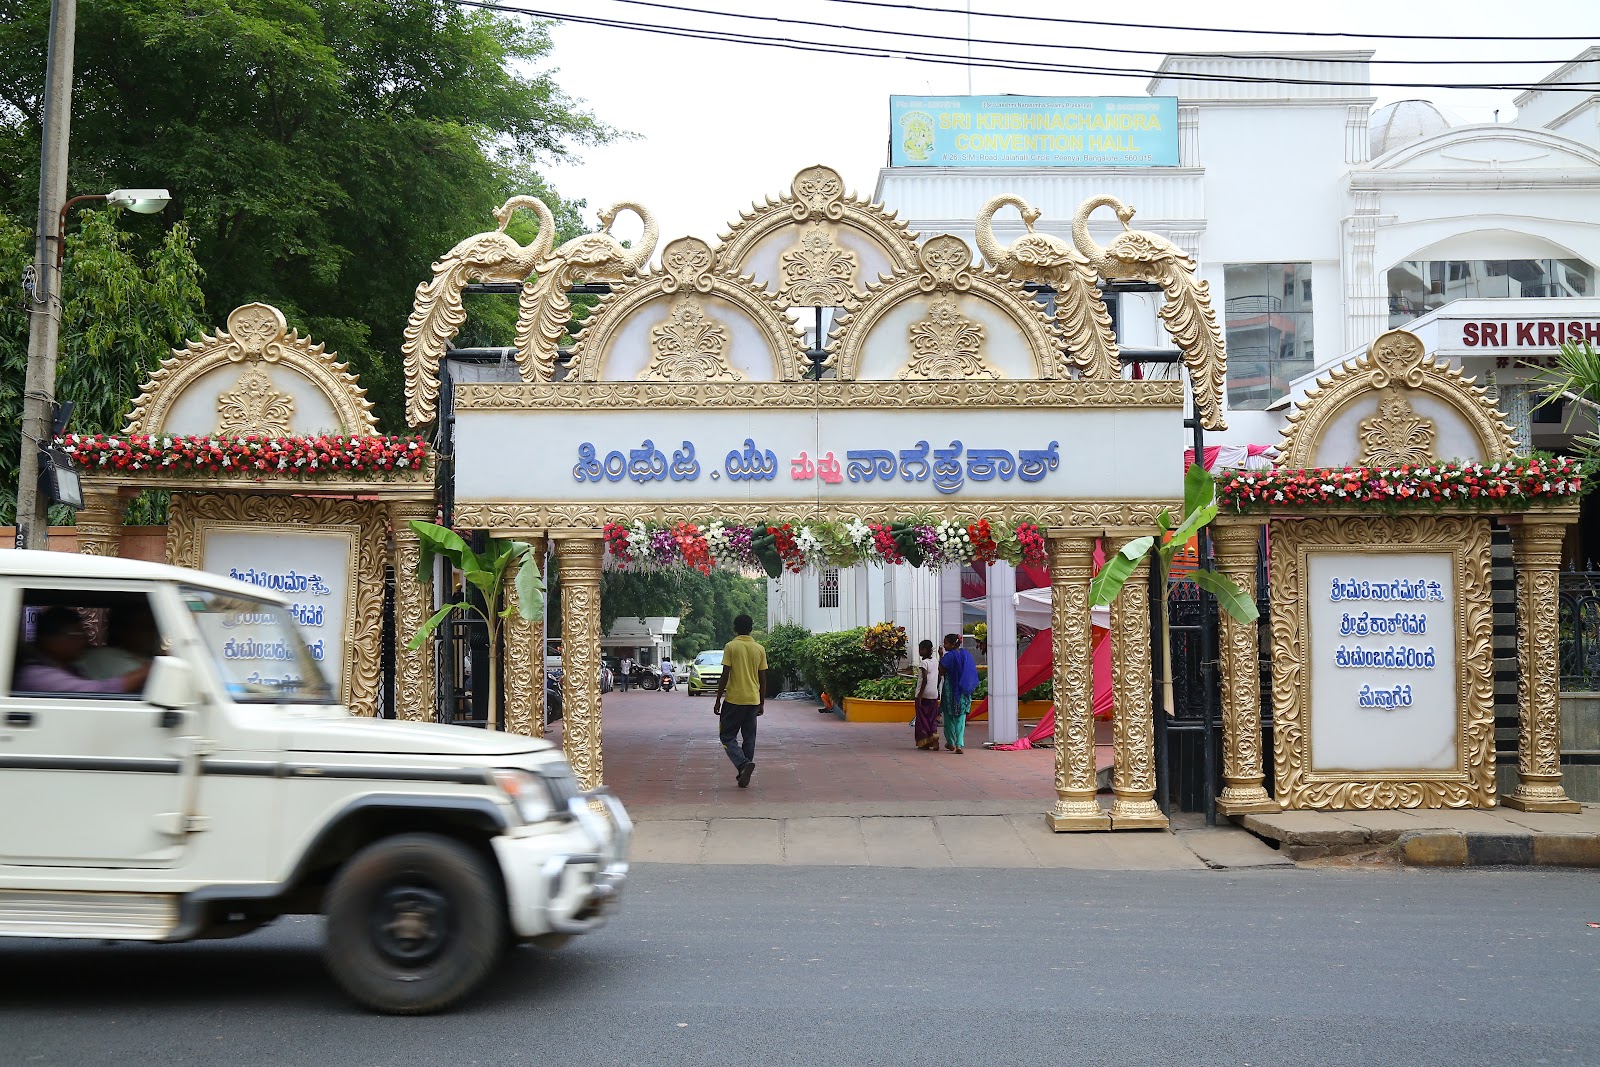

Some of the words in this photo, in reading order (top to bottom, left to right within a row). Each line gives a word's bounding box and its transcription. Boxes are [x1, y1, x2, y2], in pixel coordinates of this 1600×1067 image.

[939, 113, 971, 130] SRI
[976, 113, 1161, 130] KRISHNACHANDRA
[955, 133, 1084, 151] CONVENTION
[1089, 134, 1140, 151] HALL
[1084, 154, 1118, 163] Bangalore
[1462, 322, 1508, 346] SRI
[1516, 322, 1600, 346] KRISH
[790, 451, 844, 484] ಮತ್ತು
[846, 439, 1060, 494] ನಾಗಪ್ರಕಾಶ್
